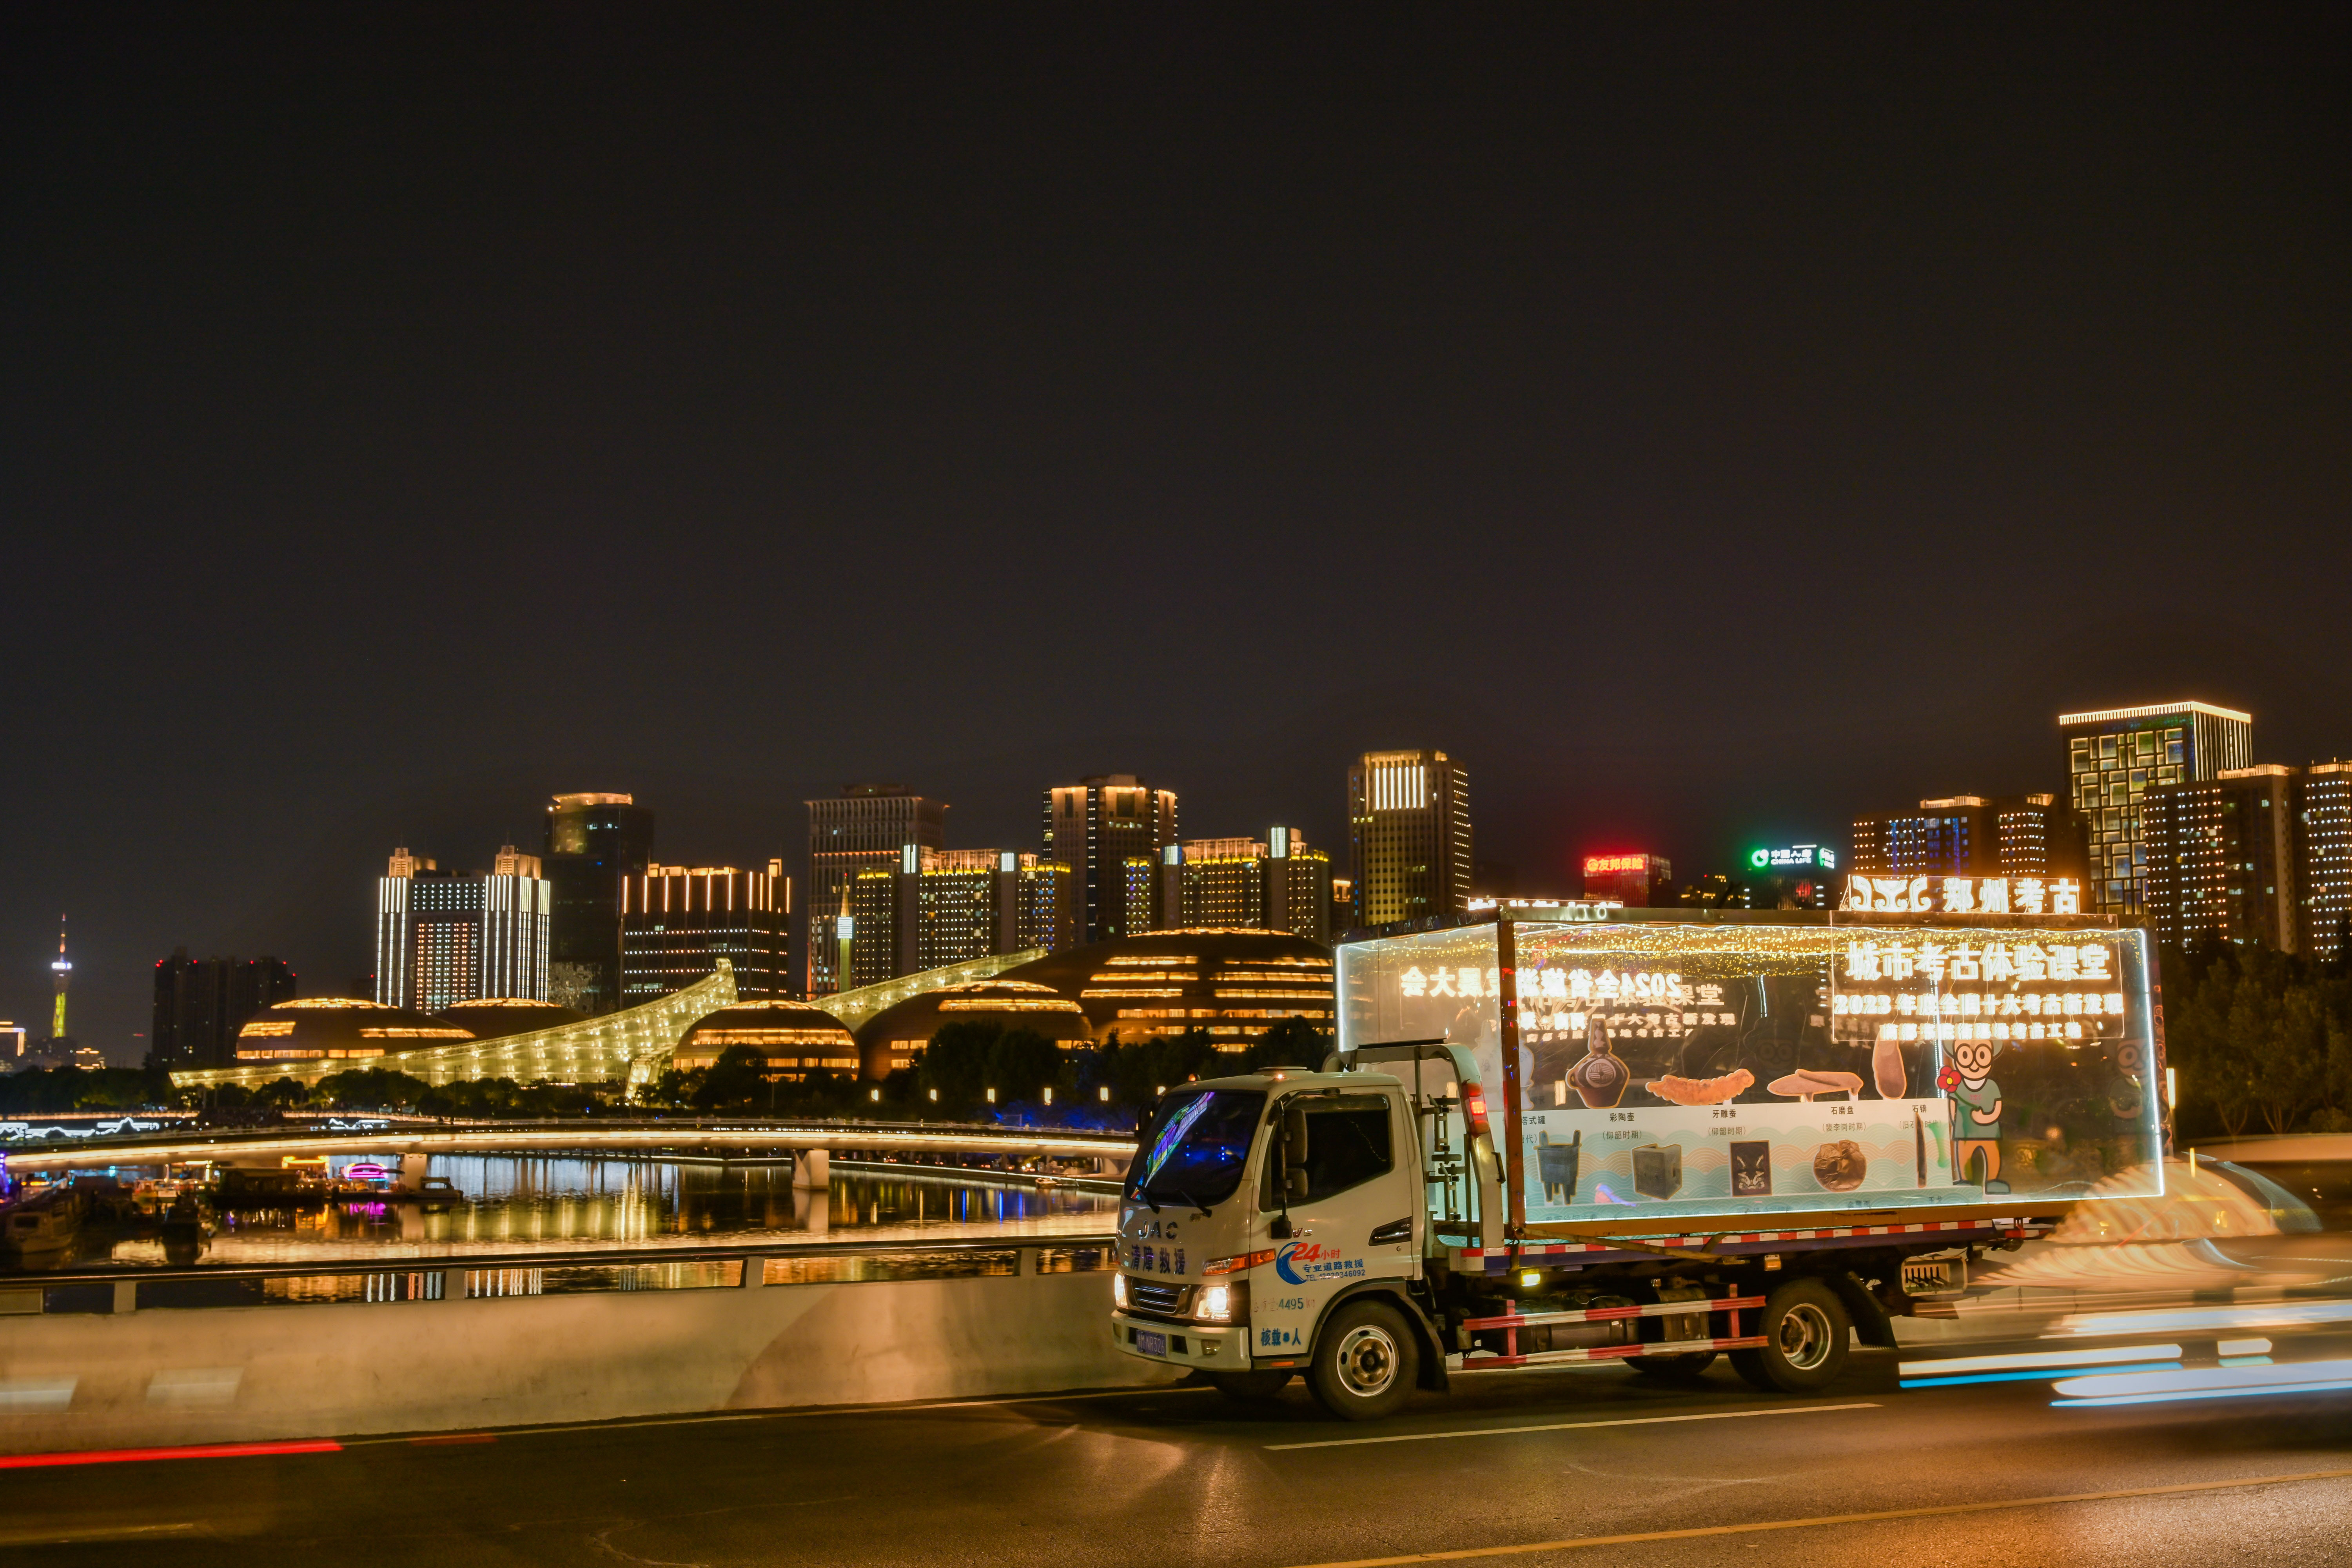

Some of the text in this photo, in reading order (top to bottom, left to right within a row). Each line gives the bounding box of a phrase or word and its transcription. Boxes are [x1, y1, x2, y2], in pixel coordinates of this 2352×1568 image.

[1598, 857, 1644, 871] 友邦保险
[1943, 877, 2080, 914] 郑州考古
[1846, 941, 2111, 981] 城市考古体验课堂
[1609, 1112, 1635, 1122] 彩陶壶
[1712, 1109, 1737, 1118] 牙雕蚕
[1831, 1106, 1854, 1115] 石磨盘
[1138, 1220, 1178, 1240] JAC
[1302, 1259, 1364, 1273] 专业道路救援
